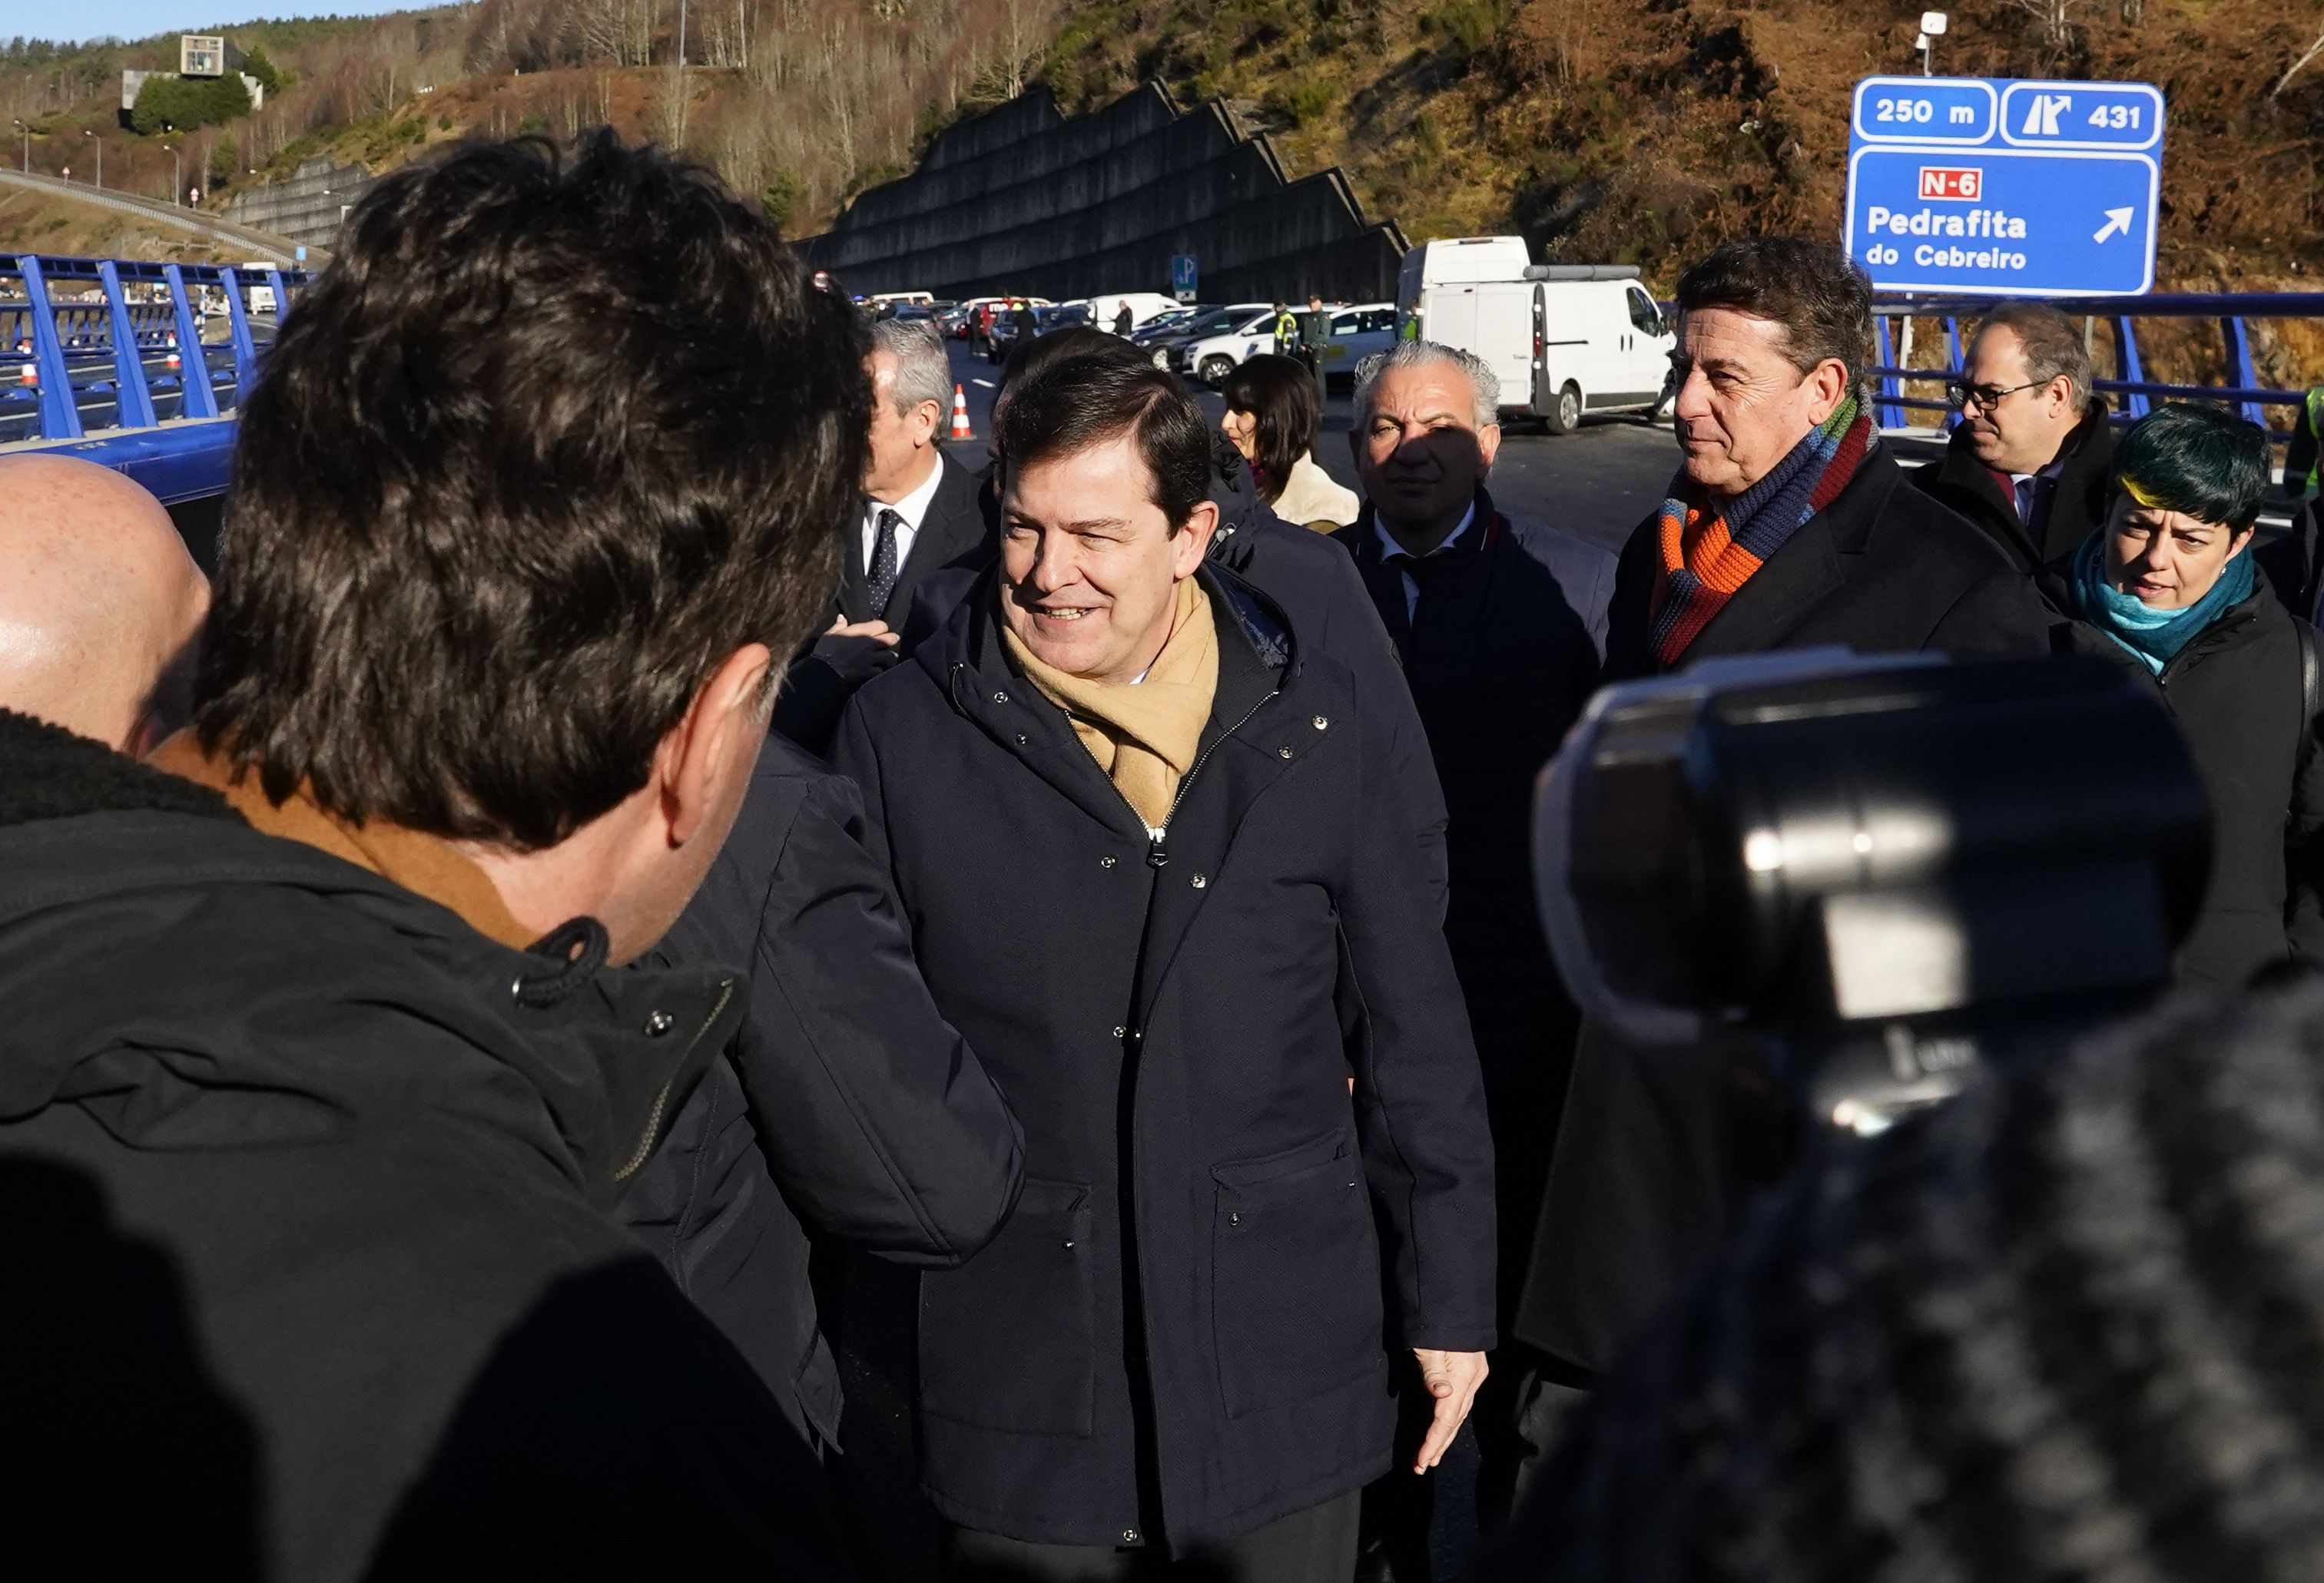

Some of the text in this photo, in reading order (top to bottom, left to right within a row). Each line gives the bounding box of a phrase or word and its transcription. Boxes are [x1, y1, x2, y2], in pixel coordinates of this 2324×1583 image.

[1876, 98, 1974, 124] 250 m
[2087, 105, 2140, 129] 431
[1924, 172, 1976, 196] N-6
[1868, 206, 2027, 239] Pedrafita
[1865, 243, 2027, 270] do Cebreiro
